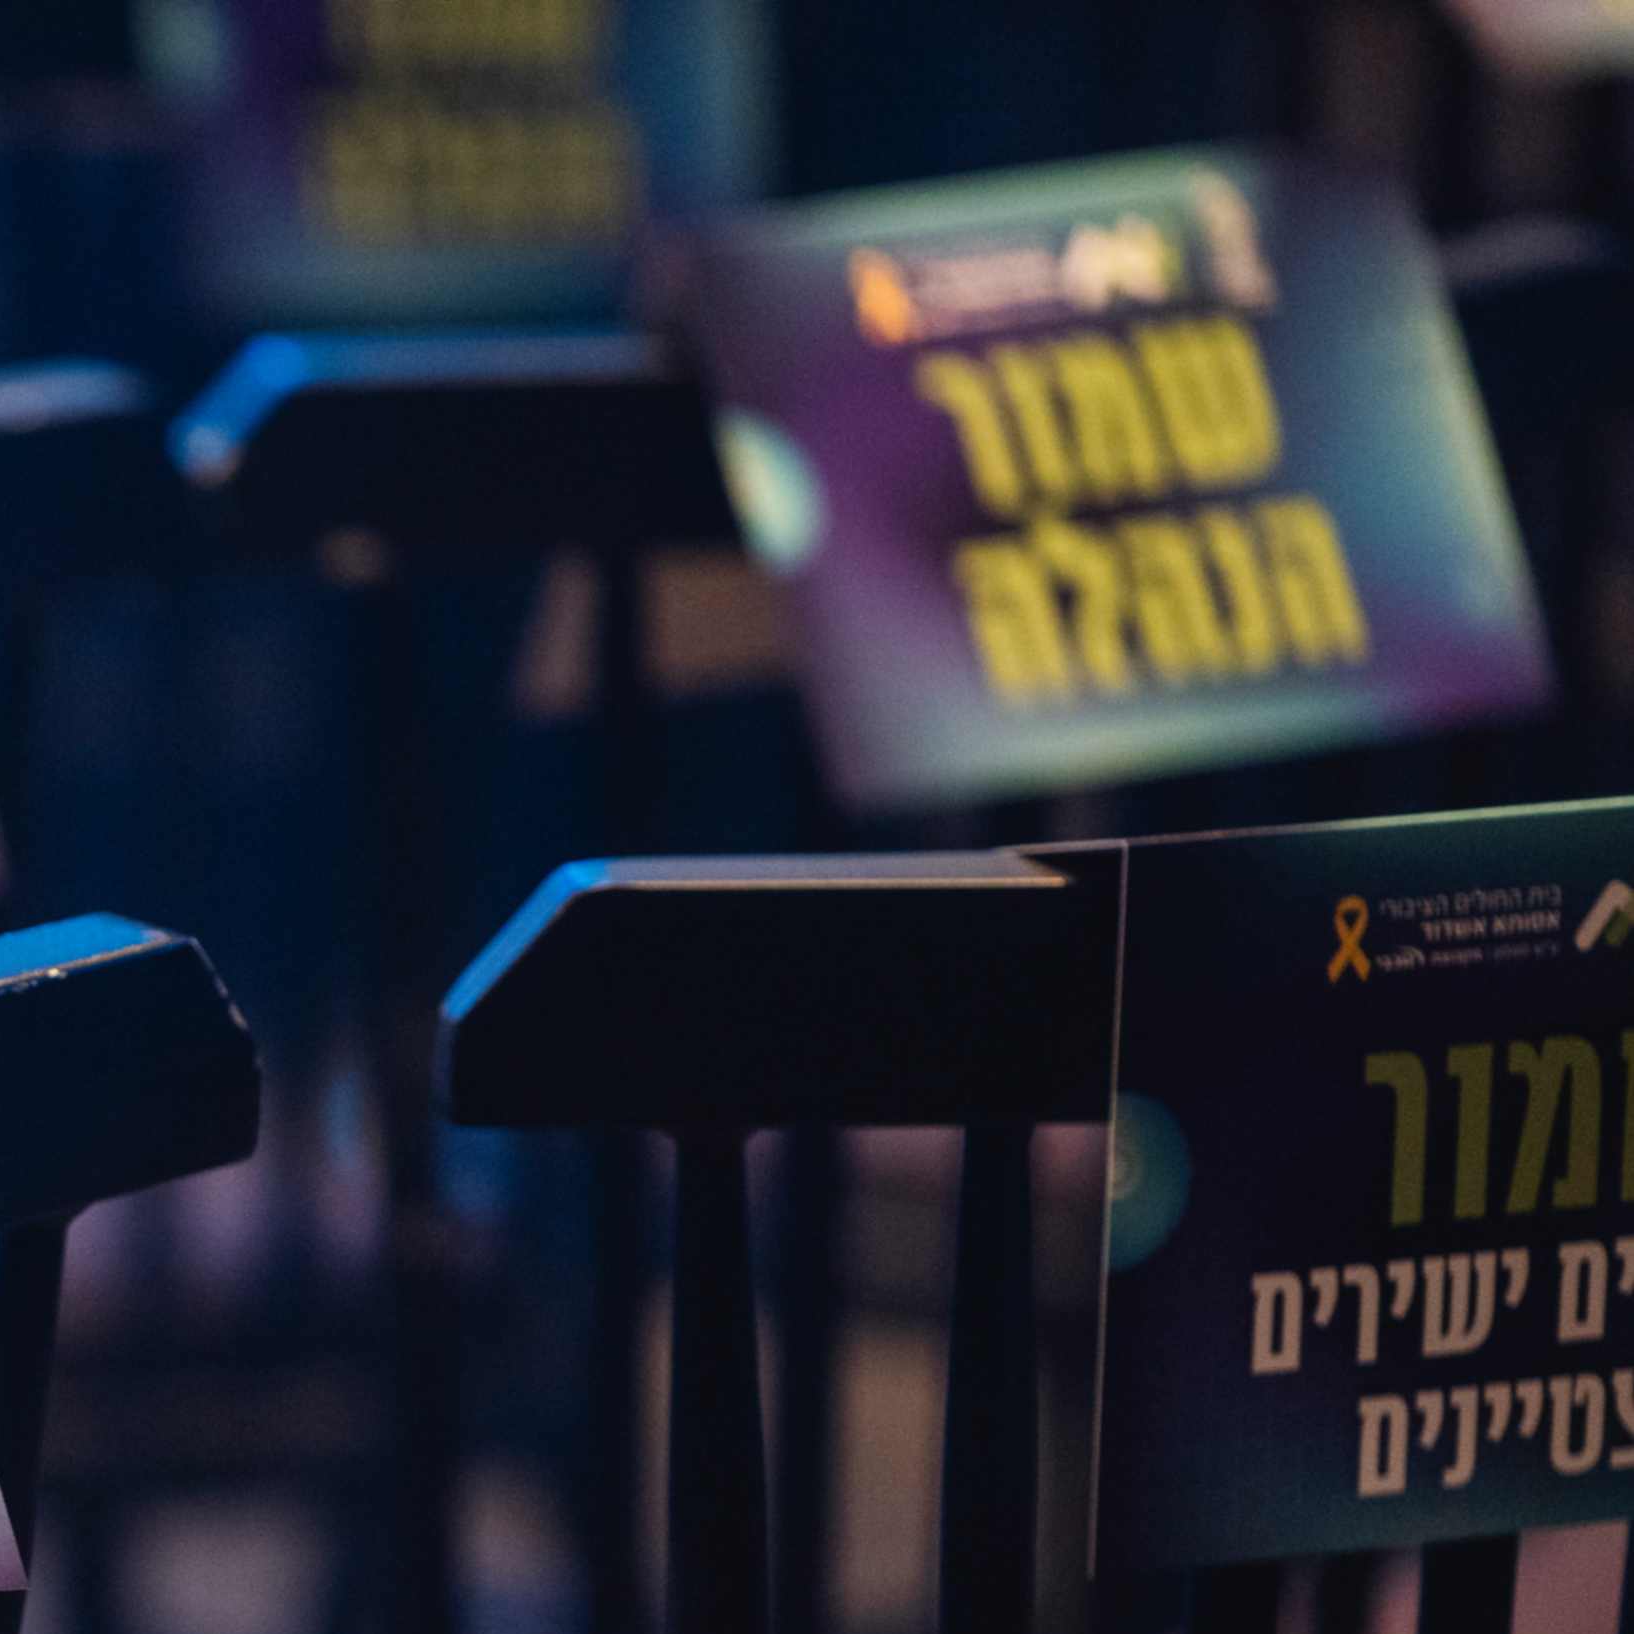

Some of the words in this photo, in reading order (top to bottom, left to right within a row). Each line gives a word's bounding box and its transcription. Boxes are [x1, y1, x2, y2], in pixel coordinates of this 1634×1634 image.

[914, 317, 1281, 514] שמור
[1364, 1029, 1634, 1227] מור
[1250, 1246, 1530, 1376] ישירים
[1358, 1366, 1634, 1498] טיינים
